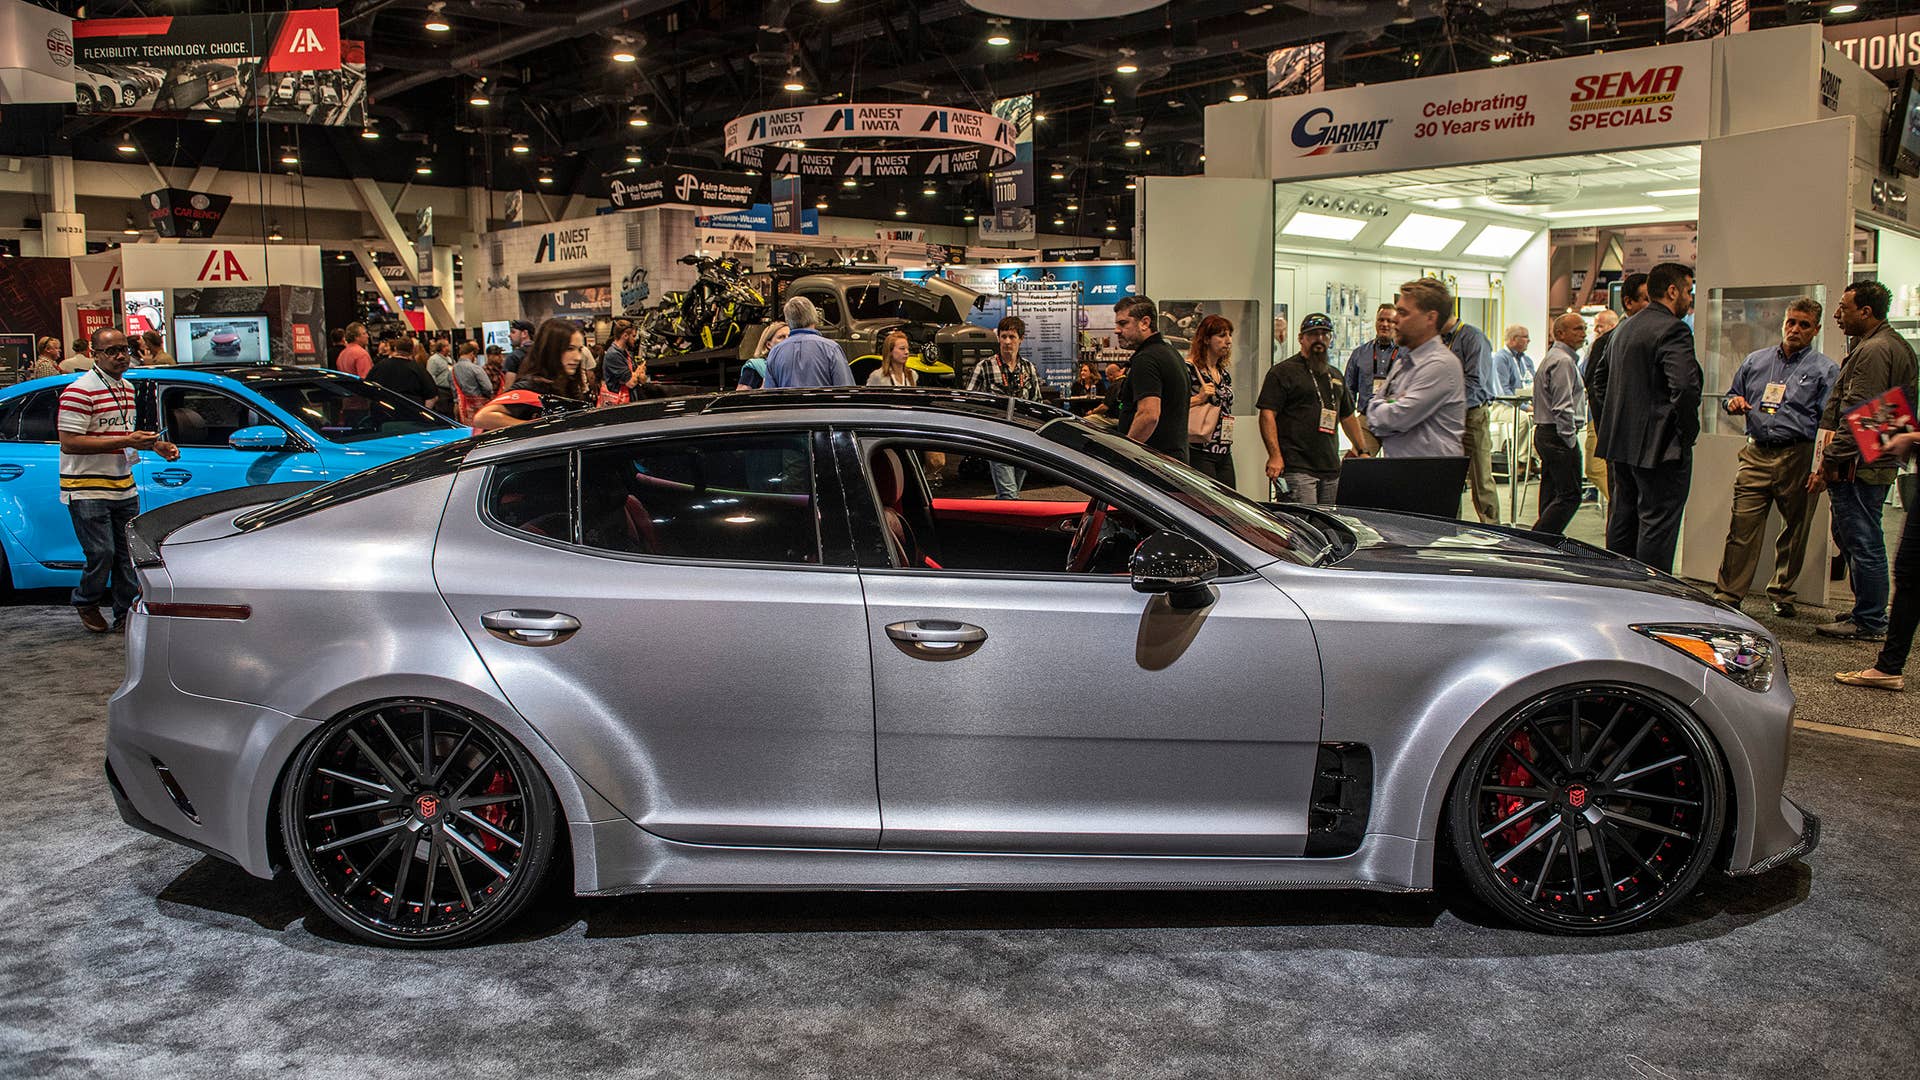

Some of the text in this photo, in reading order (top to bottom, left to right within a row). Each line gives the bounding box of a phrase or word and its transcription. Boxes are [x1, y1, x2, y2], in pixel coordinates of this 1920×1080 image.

[46, 39, 73, 58] GFS
[84, 42, 249, 59] FLEXIBILITY. TECHNOLOGY. CHOICE.
[1833, 31, 1920, 70] TIONS
[1570, 65, 1684, 102] SEMA
[1423, 94, 1527, 118] Celebrating
[1621, 94, 1672, 105] SHOW
[769, 111, 805, 126] ANEST
[859, 108, 903, 119] ANEST
[952, 112, 984, 127] ANEST
[1568, 105, 1673, 131] SPECIALS
[771, 123, 802, 137] IWATA
[862, 120, 900, 131] IWATA
[954, 124, 982, 138] IWATA
[1414, 111, 1536, 139] 30 Years with
[1345, 141, 1378, 152] USA
[801, 155, 836, 165] ANEST
[874, 156, 911, 166] ANEST
[951, 150, 980, 163] ANEST
[802, 165, 833, 175] IWATA
[876, 166, 908, 176] IWATA
[953, 160, 978, 173] IWATA
[626, 180, 663, 193] Astro Pneumatic
[700, 182, 753, 195] Astro Pneumatic
[996, 183, 1017, 203] 11100
[630, 190, 663, 201] Tool Company
[703, 191, 748, 204] Tool Company
[558, 227, 590, 245] ANEST
[560, 245, 588, 261] IWATA
[86, 315, 111, 324] BUILT
